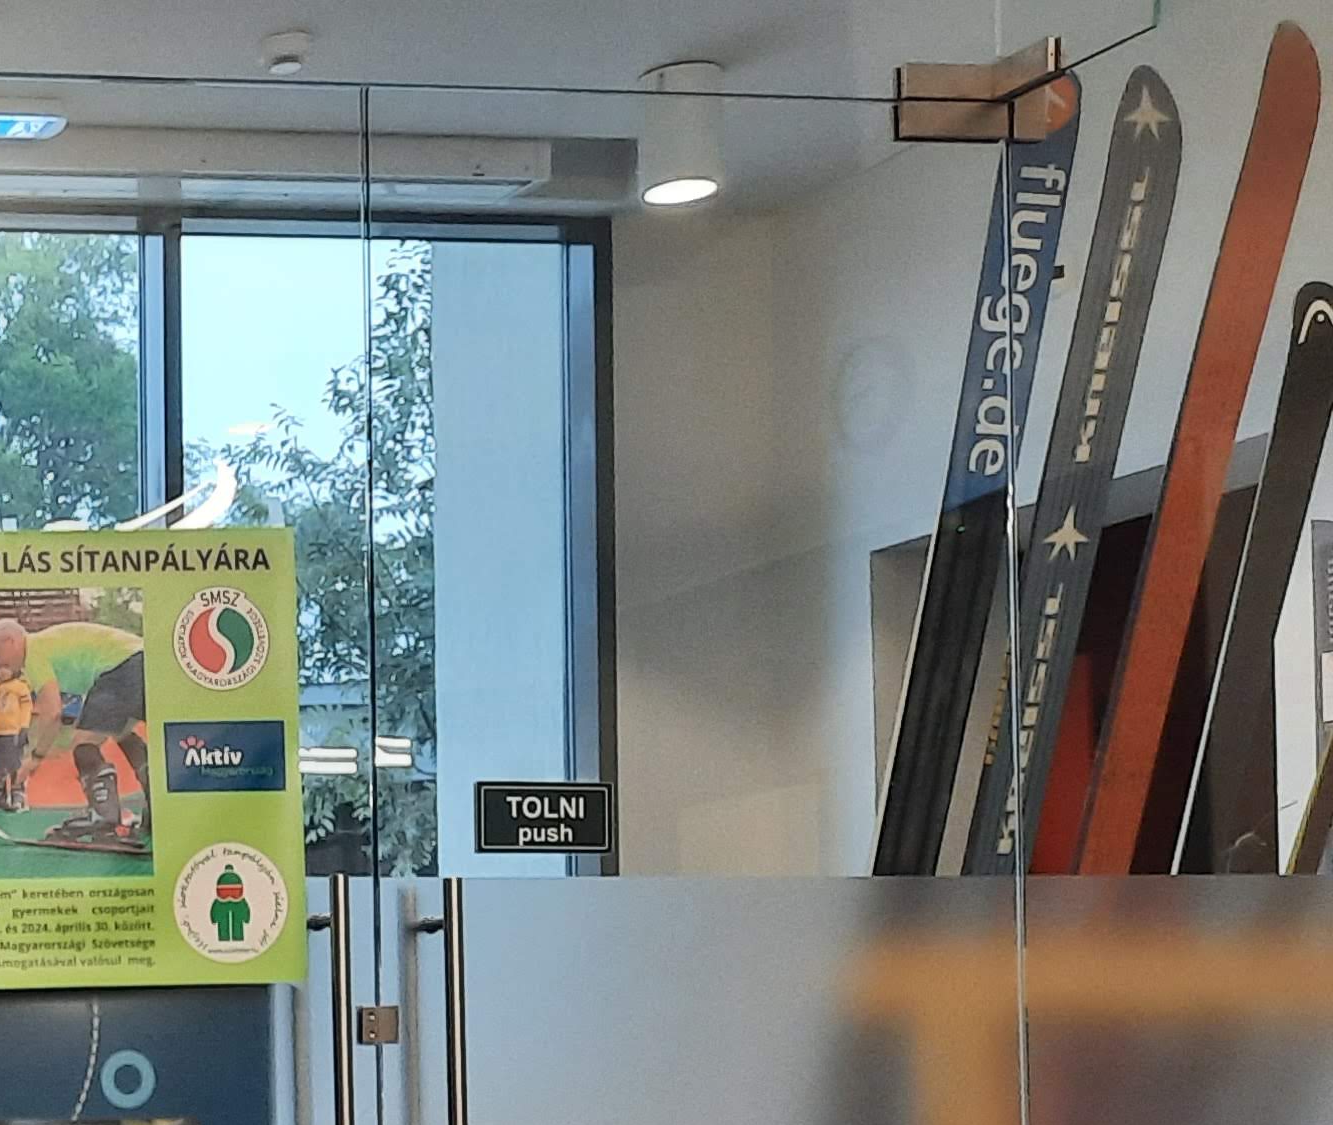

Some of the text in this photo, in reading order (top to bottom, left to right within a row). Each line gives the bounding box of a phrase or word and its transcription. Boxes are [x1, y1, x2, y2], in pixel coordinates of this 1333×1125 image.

[968, 164, 1067, 476] fluege.de
[60, 542, 271, 573] SÍTANPÁLYÁRA
[199, 588, 241, 608] SMSZ
[506, 796, 585, 819] TOLNI
[518, 823, 573, 846] push
[22, 887, 83, 900] keretében
[89, 887, 154, 900] országosan
[12, 905, 78, 919] gyermekek
[5, 924, 17, 934] és
[55, 923, 91, 936] április
[0, 939, 86, 954] Magyarországi
[92, 938, 155, 951] Szövetsége
[80, 955, 122, 967] valósul
